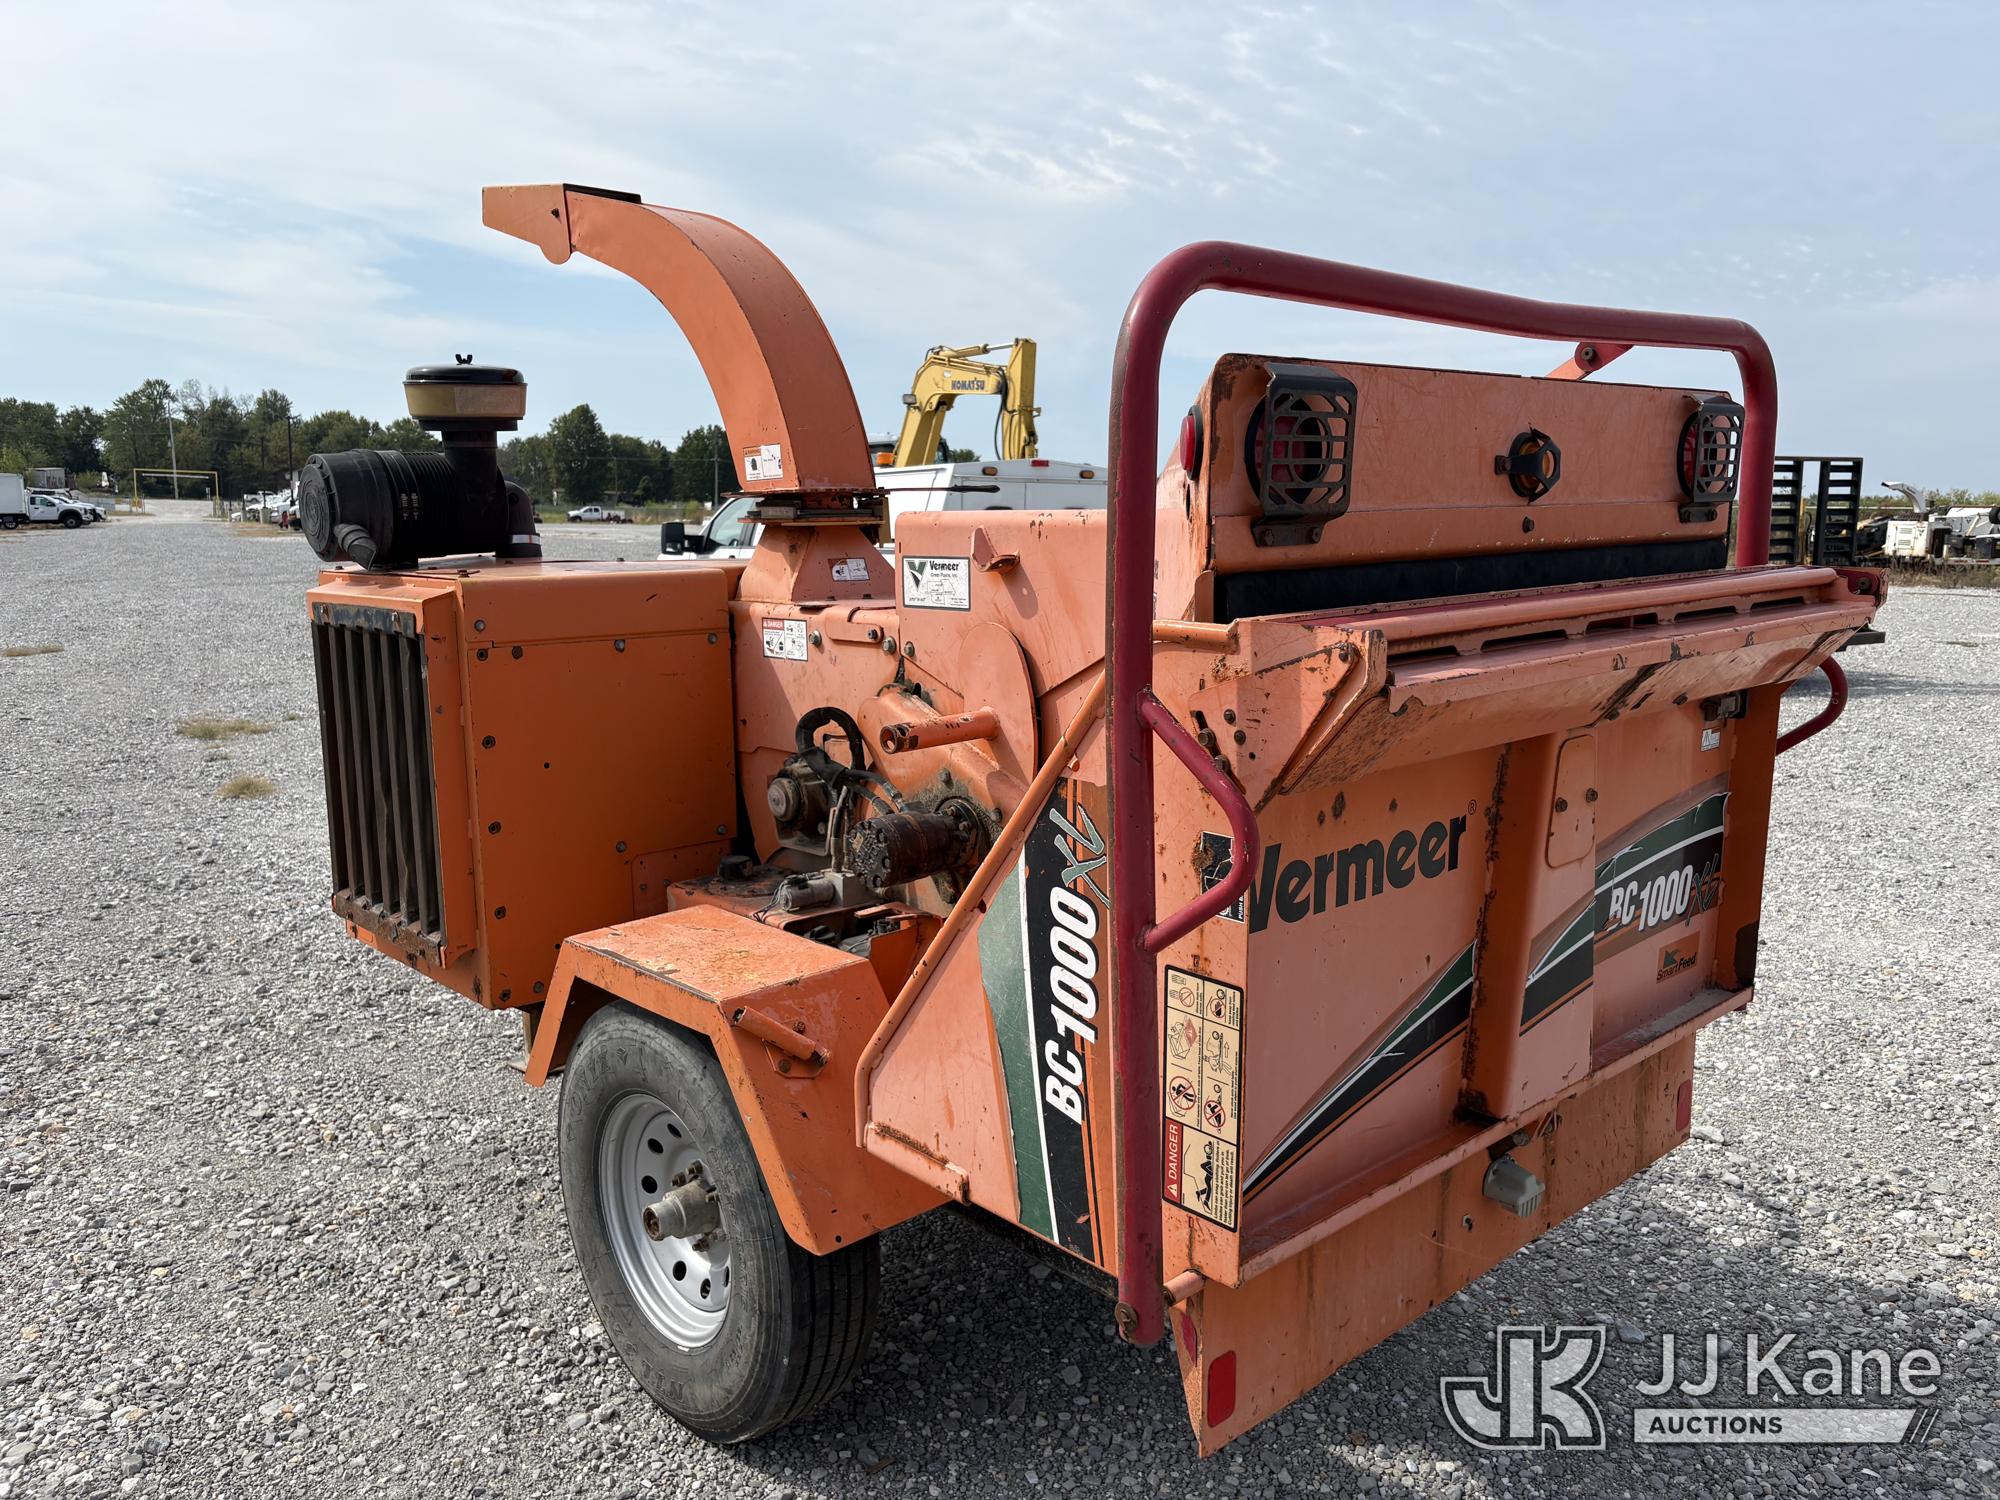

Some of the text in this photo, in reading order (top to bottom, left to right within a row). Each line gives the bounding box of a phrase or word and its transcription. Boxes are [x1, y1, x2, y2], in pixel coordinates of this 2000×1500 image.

[952, 380, 984, 390] KOMATSU
[930, 560, 959, 570] Vermeer
[1168, 1124, 1178, 1180] DANGER
